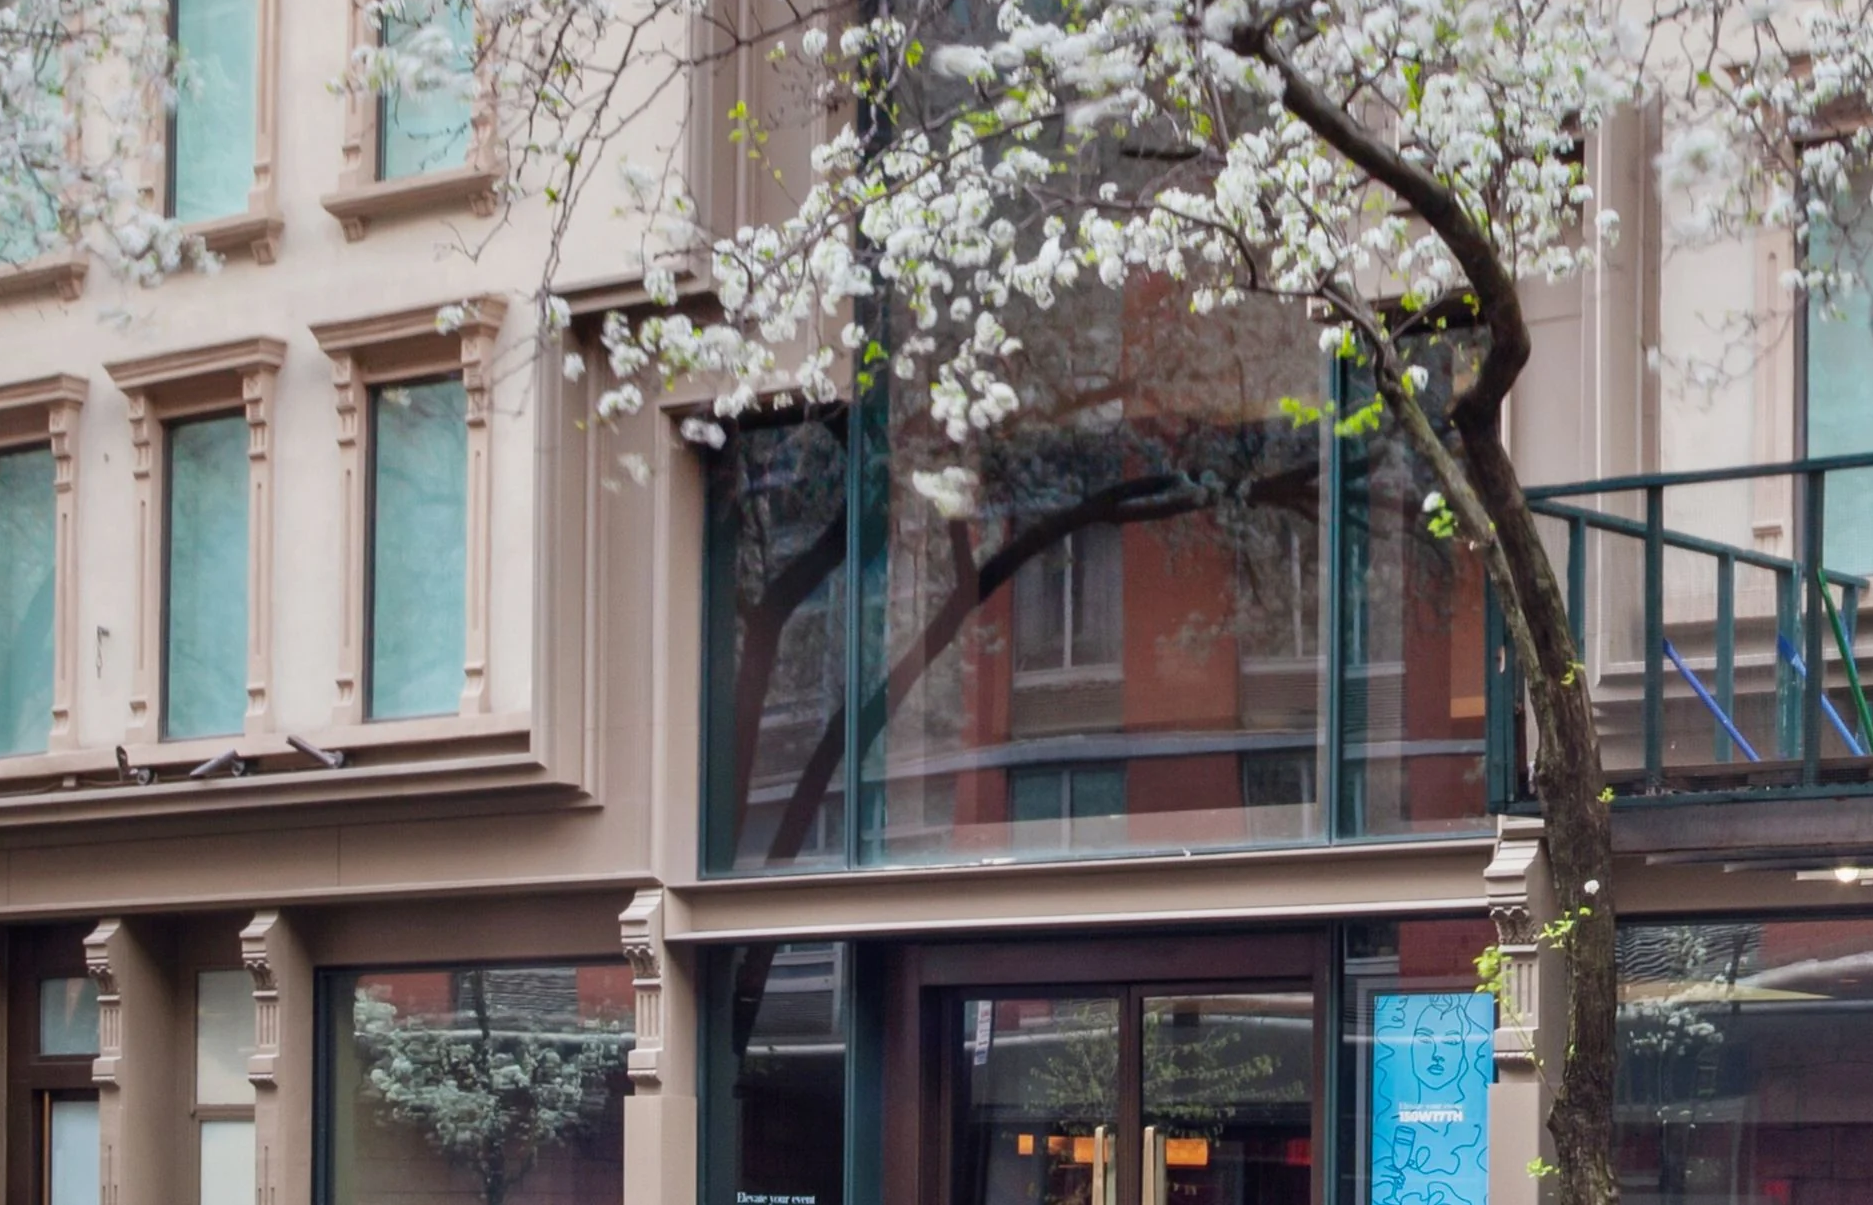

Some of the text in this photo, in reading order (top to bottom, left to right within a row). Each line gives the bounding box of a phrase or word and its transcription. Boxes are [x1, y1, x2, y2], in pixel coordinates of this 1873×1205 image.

[737, 1191, 815, 1205] Elevate your event
